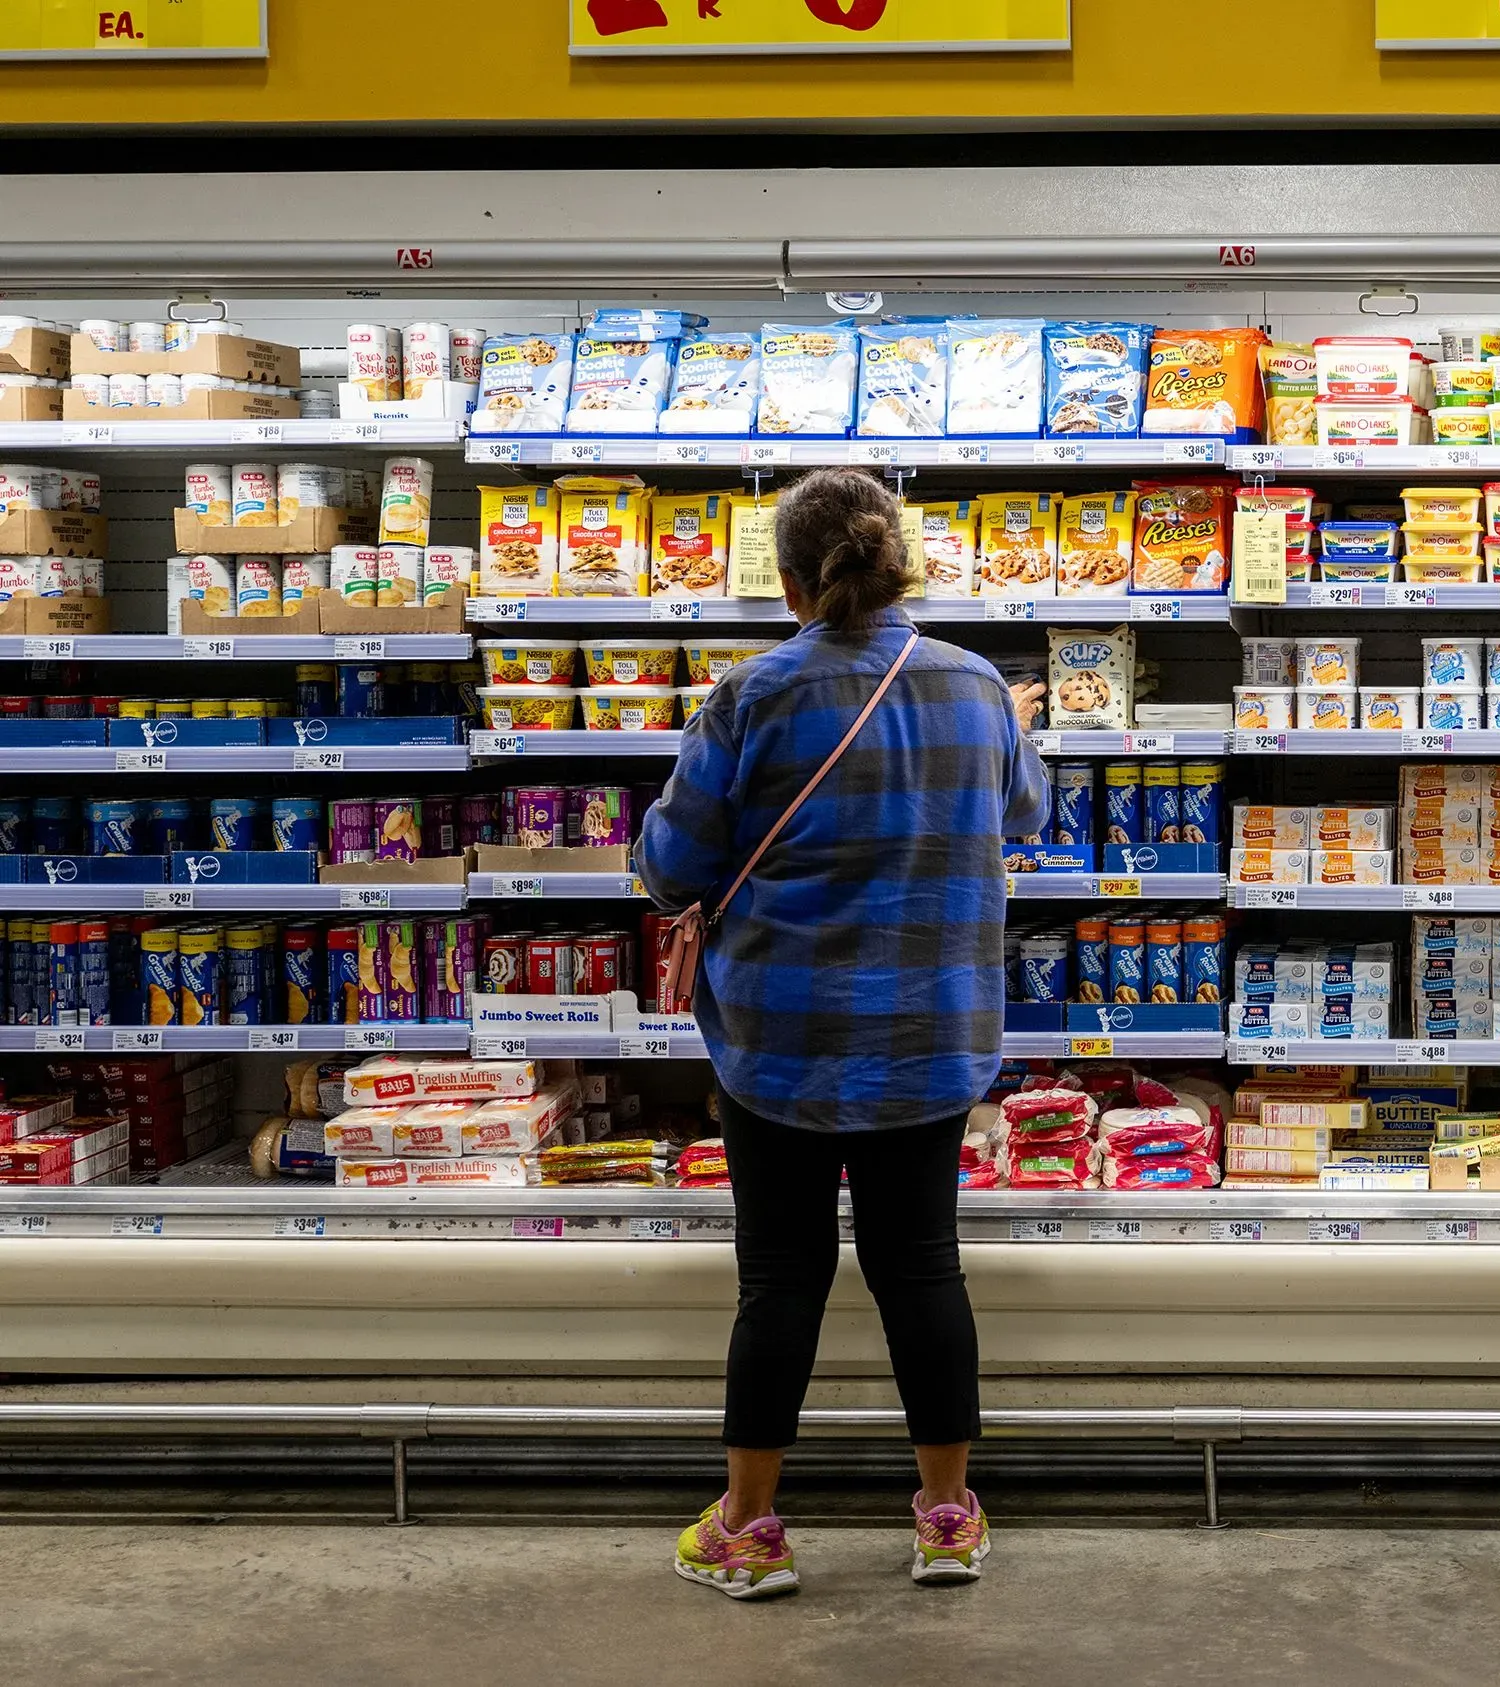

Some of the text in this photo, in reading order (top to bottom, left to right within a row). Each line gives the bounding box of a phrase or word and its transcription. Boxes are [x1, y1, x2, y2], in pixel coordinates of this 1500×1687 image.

[101, 13, 144, 40] EA.
[400, 249, 431, 269] A5
[1221, 247, 1254, 267] A6
[353, 352, 382, 363] Texas
[359, 363, 385, 376] Style
[1269, 358, 1294, 370] LAND
[485, 364, 533, 377] Cookie
[484, 376, 525, 389] Dough
[1152, 373, 1227, 398] Reese's
[1278, 384, 1299, 392] BUTTER
[1336, 420, 1356, 430] LAND
[1369, 420, 1391, 429] LAKES
[508, 505, 523, 513] TOLL
[504, 512, 526, 520] HOUSE
[493, 527, 524, 536] CHOCOLATE
[1143, 520, 1217, 546] Reese's
[1060, 645, 1112, 664] PUFF
[1041, 858, 1083, 867] Cinnamon
[1246, 862, 1270, 871] BUTTER
[1246, 873, 1269, 882] SALTED
[480, 1010, 599, 1023] Jumbo Sweet Rolls
[1244, 1017, 1270, 1026] BUTTER
[639, 1022, 695, 1032] Sweet Rolls
[1240, 1027, 1269, 1037] UNSALTED
[418, 1071, 524, 1086] English Muffins 6
[1389, 1122, 1428, 1130] UNSALTED
[411, 1160, 497, 1175] English Muffins
